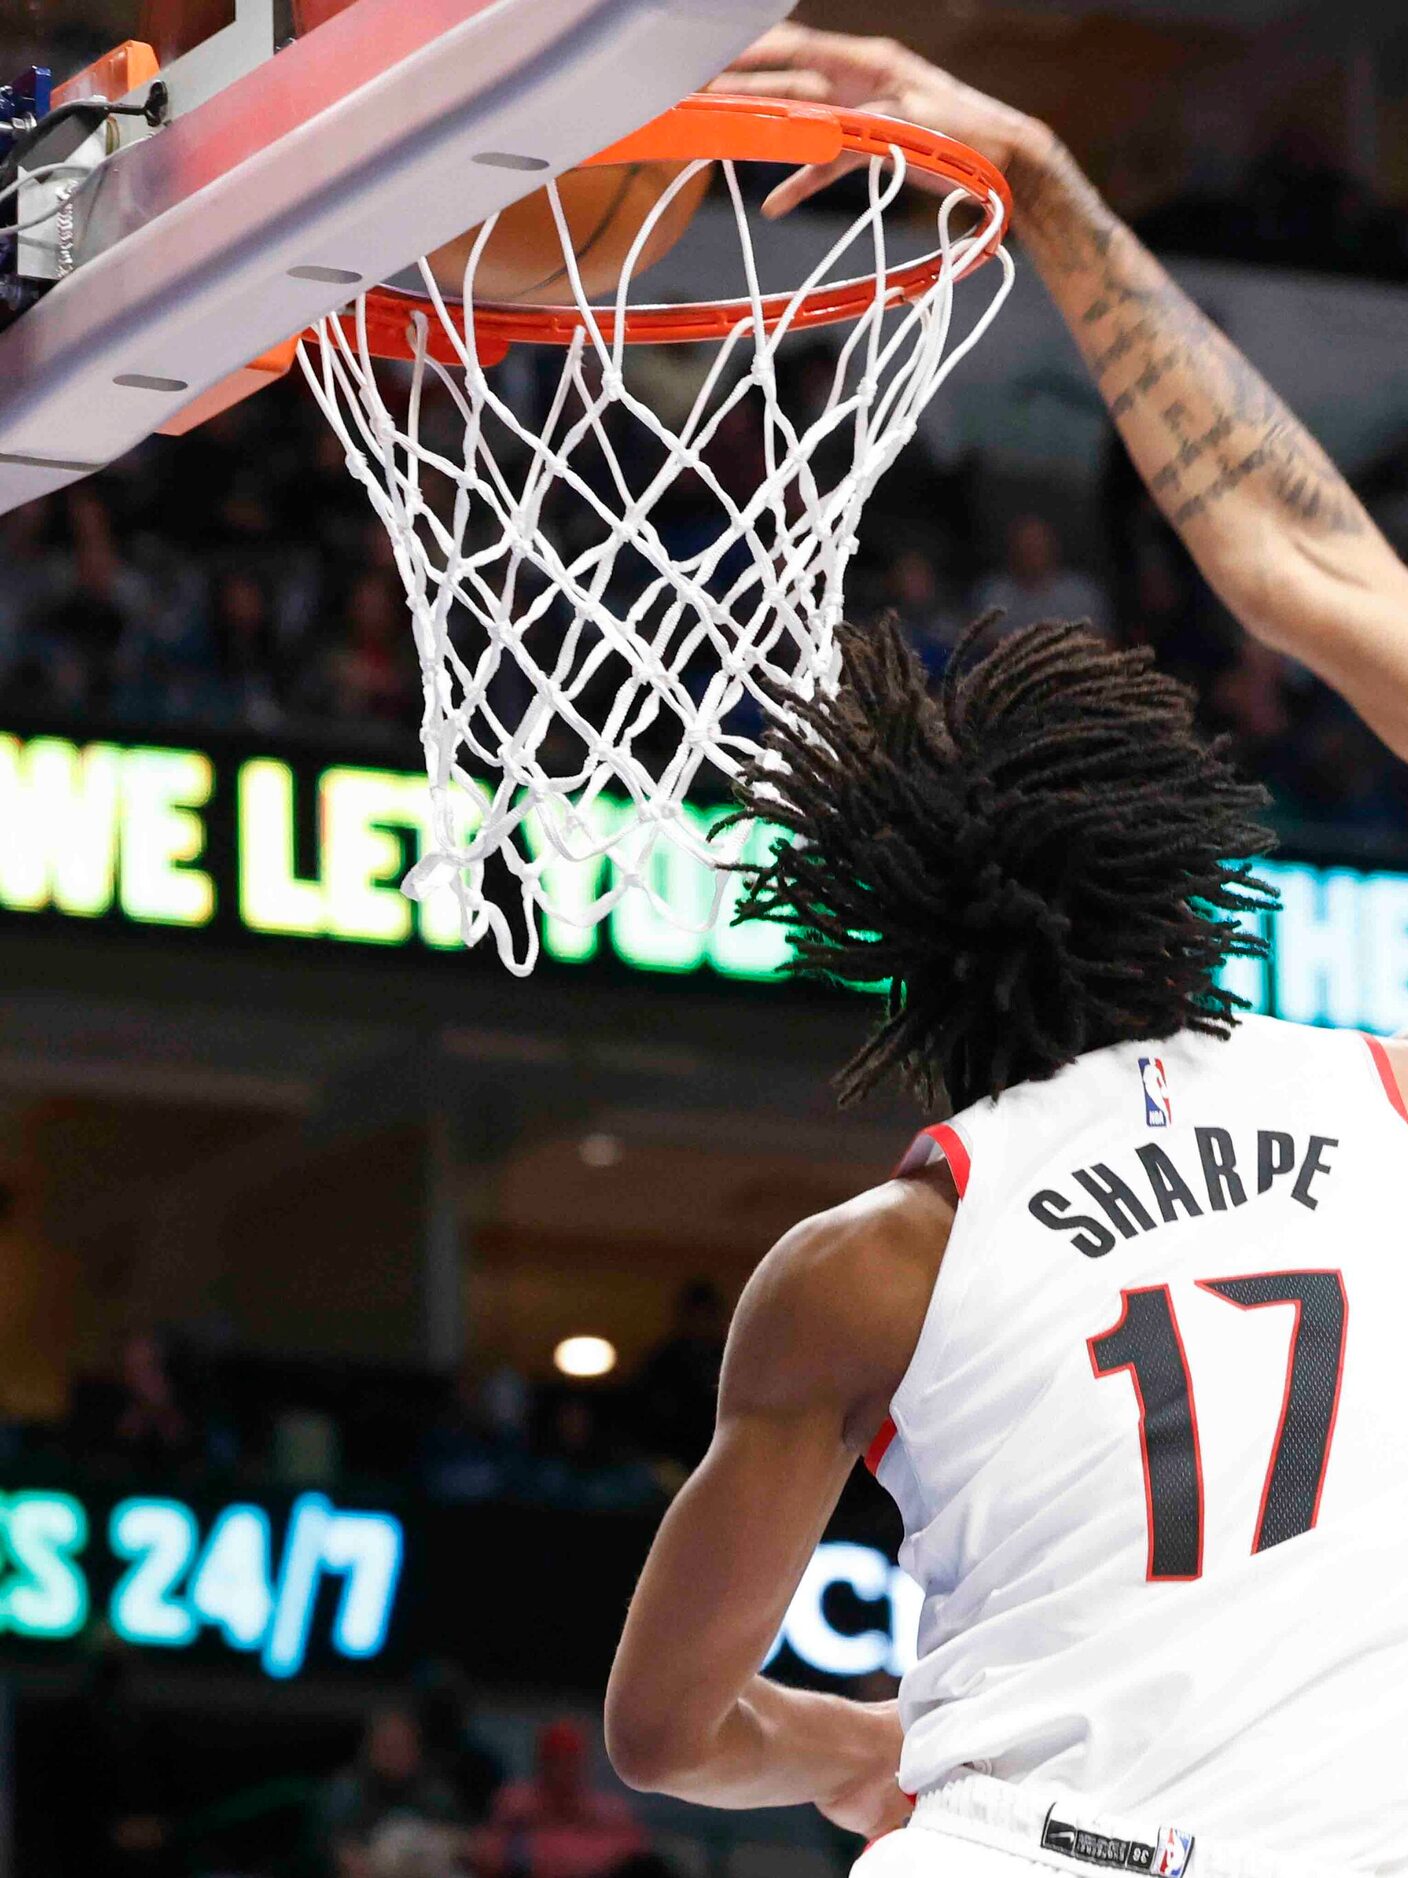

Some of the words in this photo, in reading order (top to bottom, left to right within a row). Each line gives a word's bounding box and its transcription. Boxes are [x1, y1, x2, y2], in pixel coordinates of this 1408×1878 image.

[0, 731, 215, 927] WE
[237, 757, 492, 950] LET
[1028, 1126, 1339, 1258] SHARPE
[1086, 1269, 1349, 1581] 17
[0, 1489, 89, 1640] S
[109, 1491, 402, 1679] 24/7
